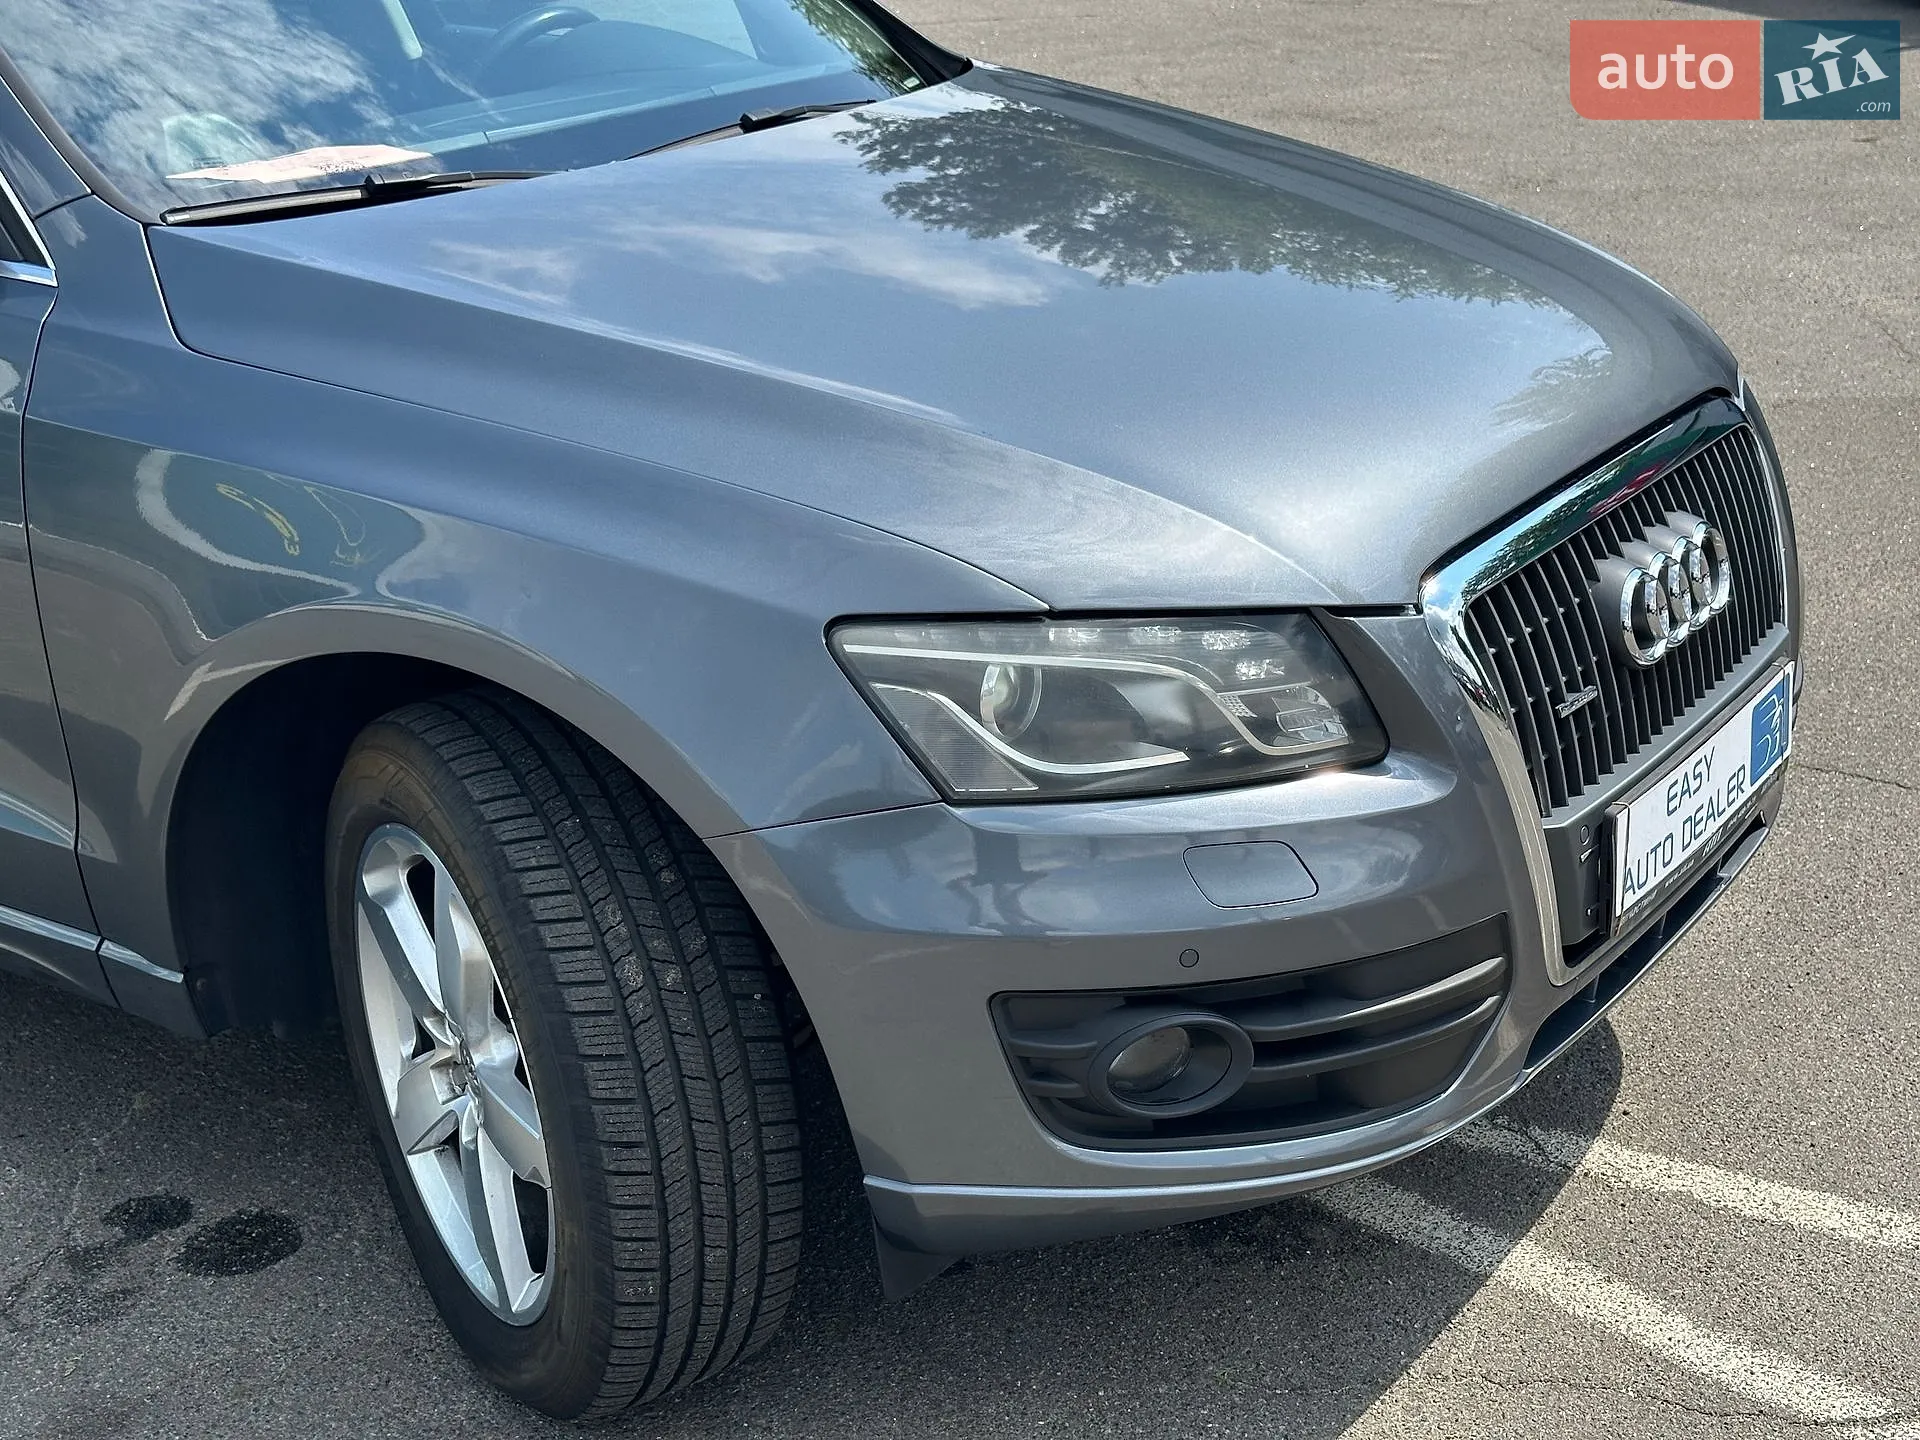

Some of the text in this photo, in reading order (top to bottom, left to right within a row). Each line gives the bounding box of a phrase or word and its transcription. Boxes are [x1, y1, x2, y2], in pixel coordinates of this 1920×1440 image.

[1624, 832, 1674, 896] AUTO
[1681, 763, 1746, 853] DEALER
[1666, 746, 1715, 817] EASY
